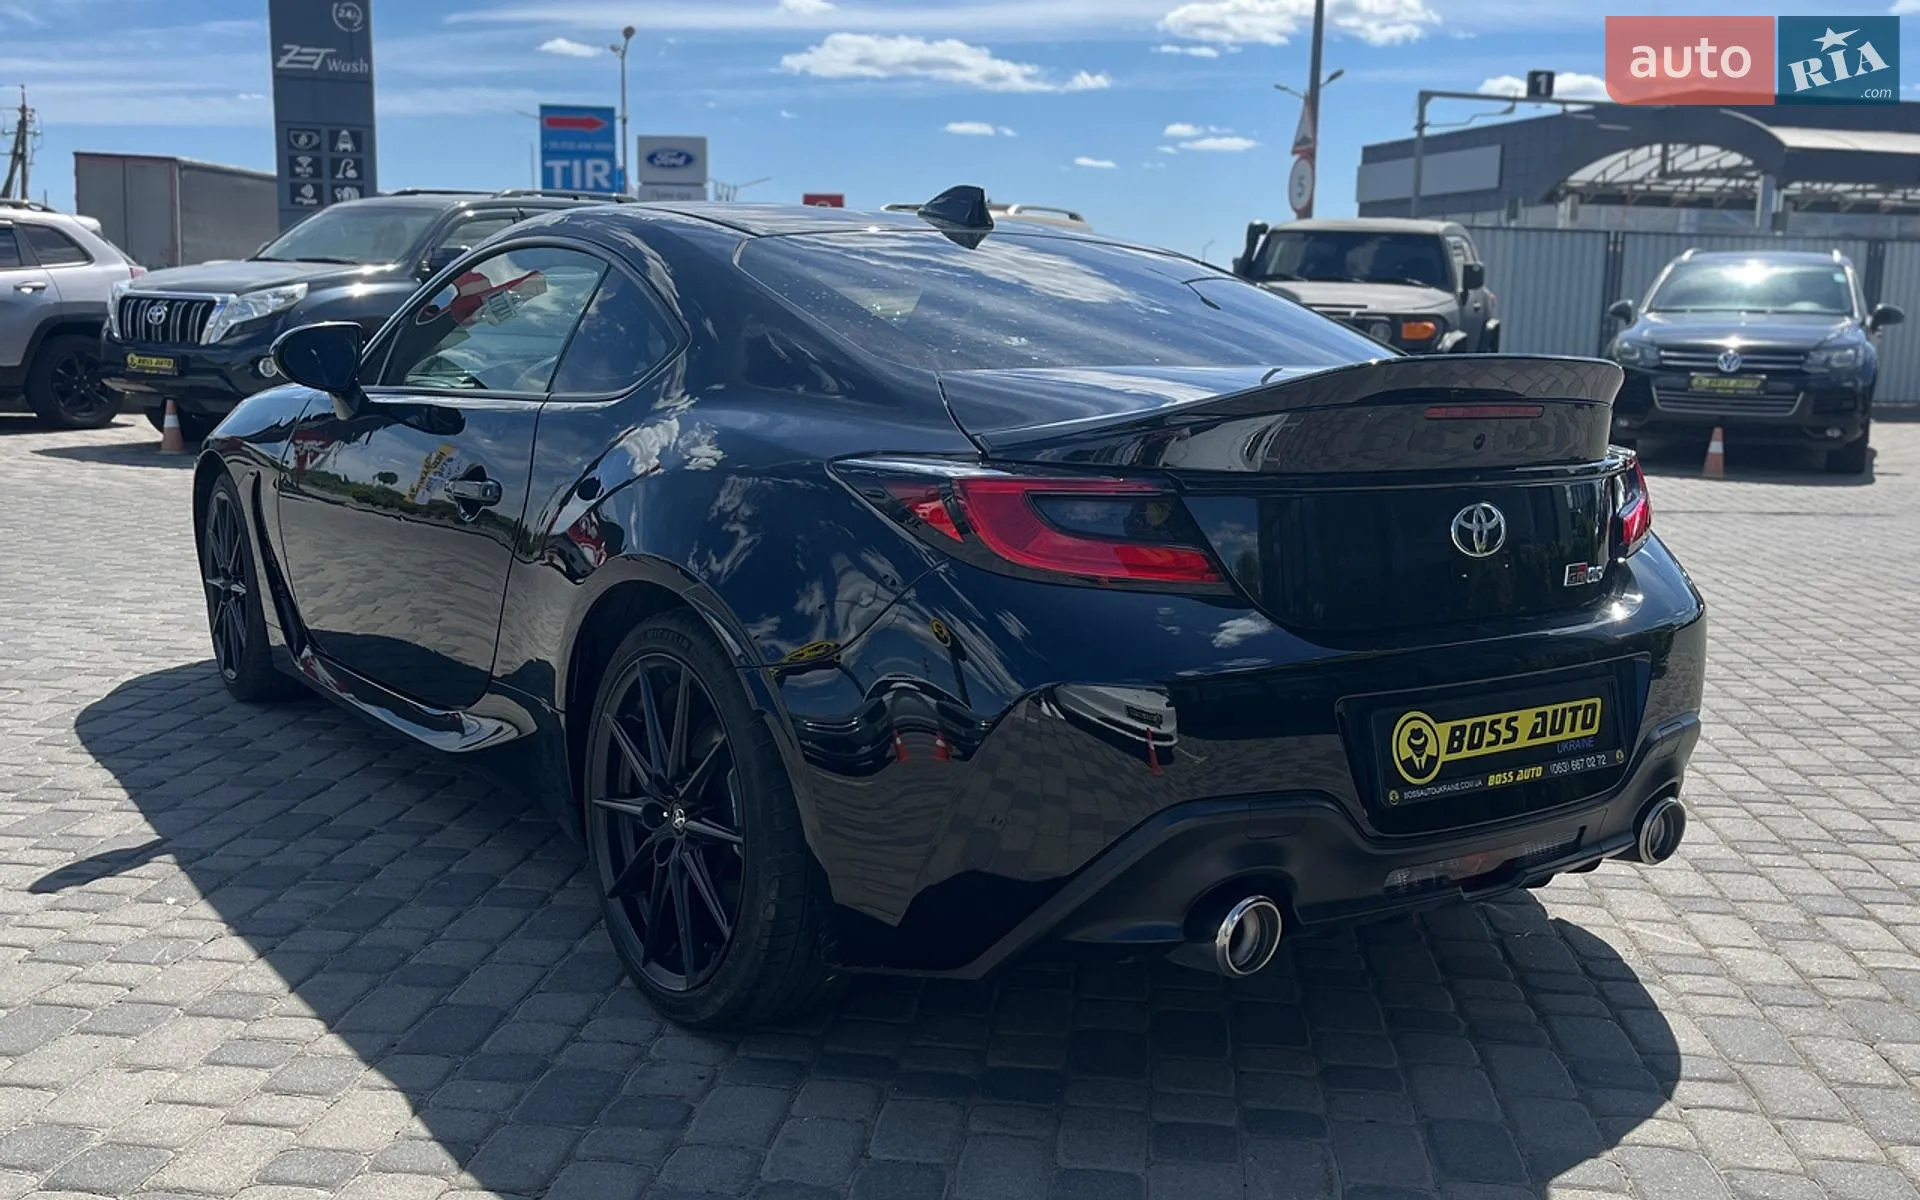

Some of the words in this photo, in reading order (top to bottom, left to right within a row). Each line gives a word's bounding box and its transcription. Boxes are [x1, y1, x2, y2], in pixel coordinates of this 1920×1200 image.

[326, 57, 369, 74] Wash
[1536, 74, 1546, 94] 1
[654, 152, 687, 166] Ford
[544, 158, 612, 190] TIR
[1297, 176, 1306, 198] 5
[1446, 716, 1519, 755] BOSS
[1527, 702, 1598, 740] AUTO
[1557, 737, 1596, 754] UKRAINE
[1487, 770, 1514, 787] BOSS
[1516, 766, 1543, 782] AUTO
[1585, 756, 1597, 769] 02
[1597, 753, 1607, 766] 72
